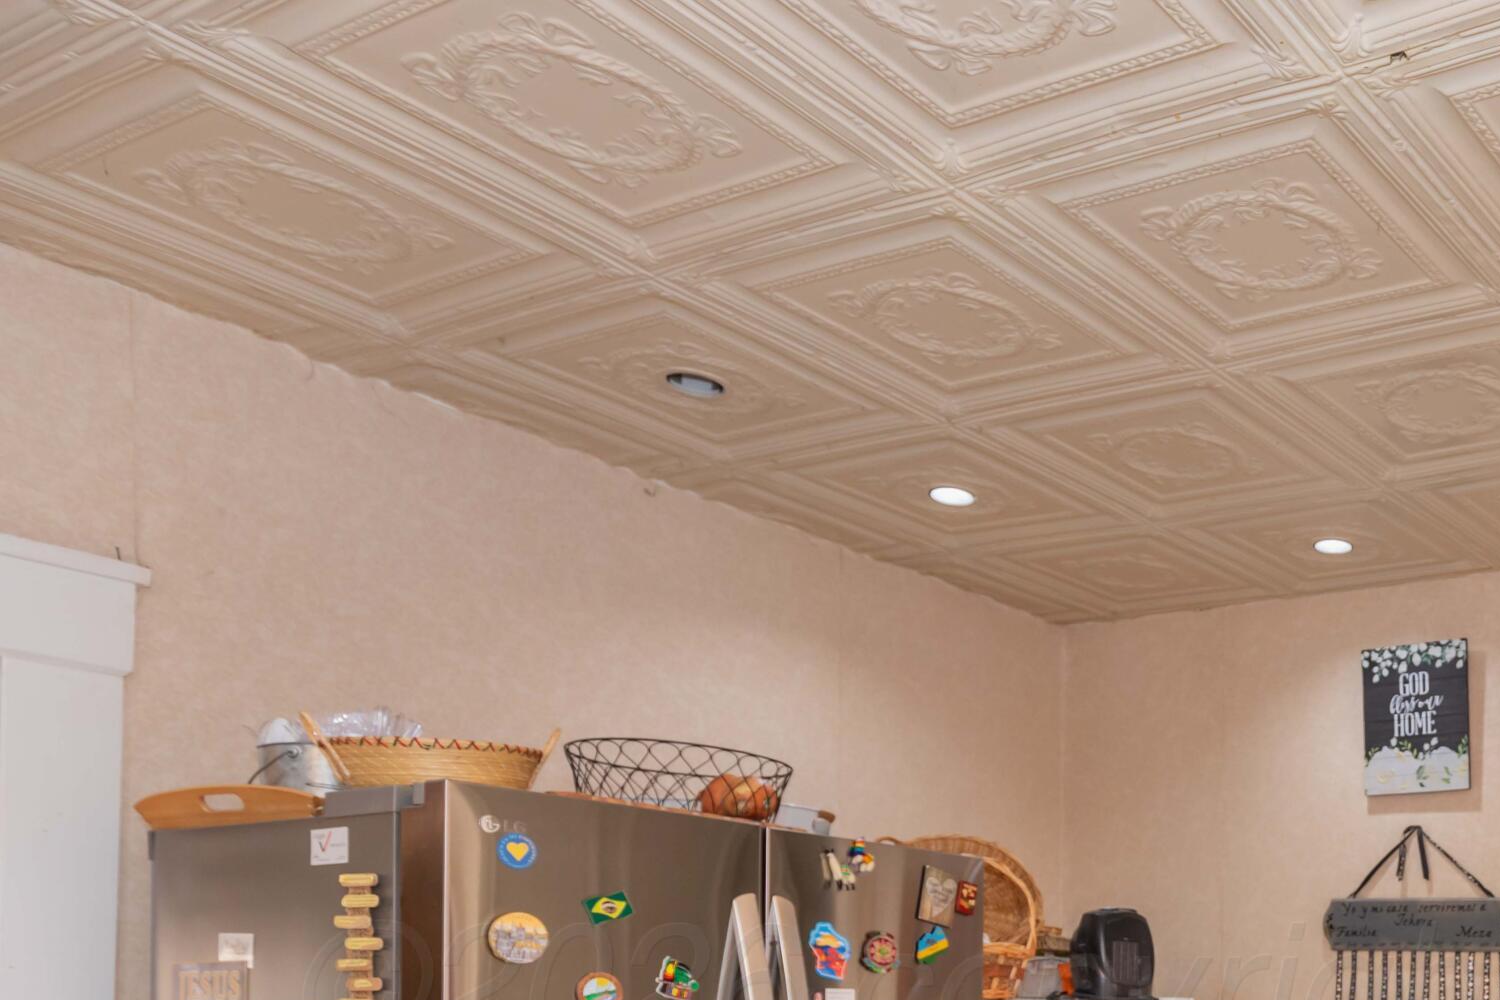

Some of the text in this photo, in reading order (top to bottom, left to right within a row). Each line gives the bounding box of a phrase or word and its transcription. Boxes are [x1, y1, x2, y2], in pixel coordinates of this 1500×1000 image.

[1399, 671, 1430, 697] GOD
[1393, 710, 1437, 737] HOME
[503, 819, 527, 833] LG
